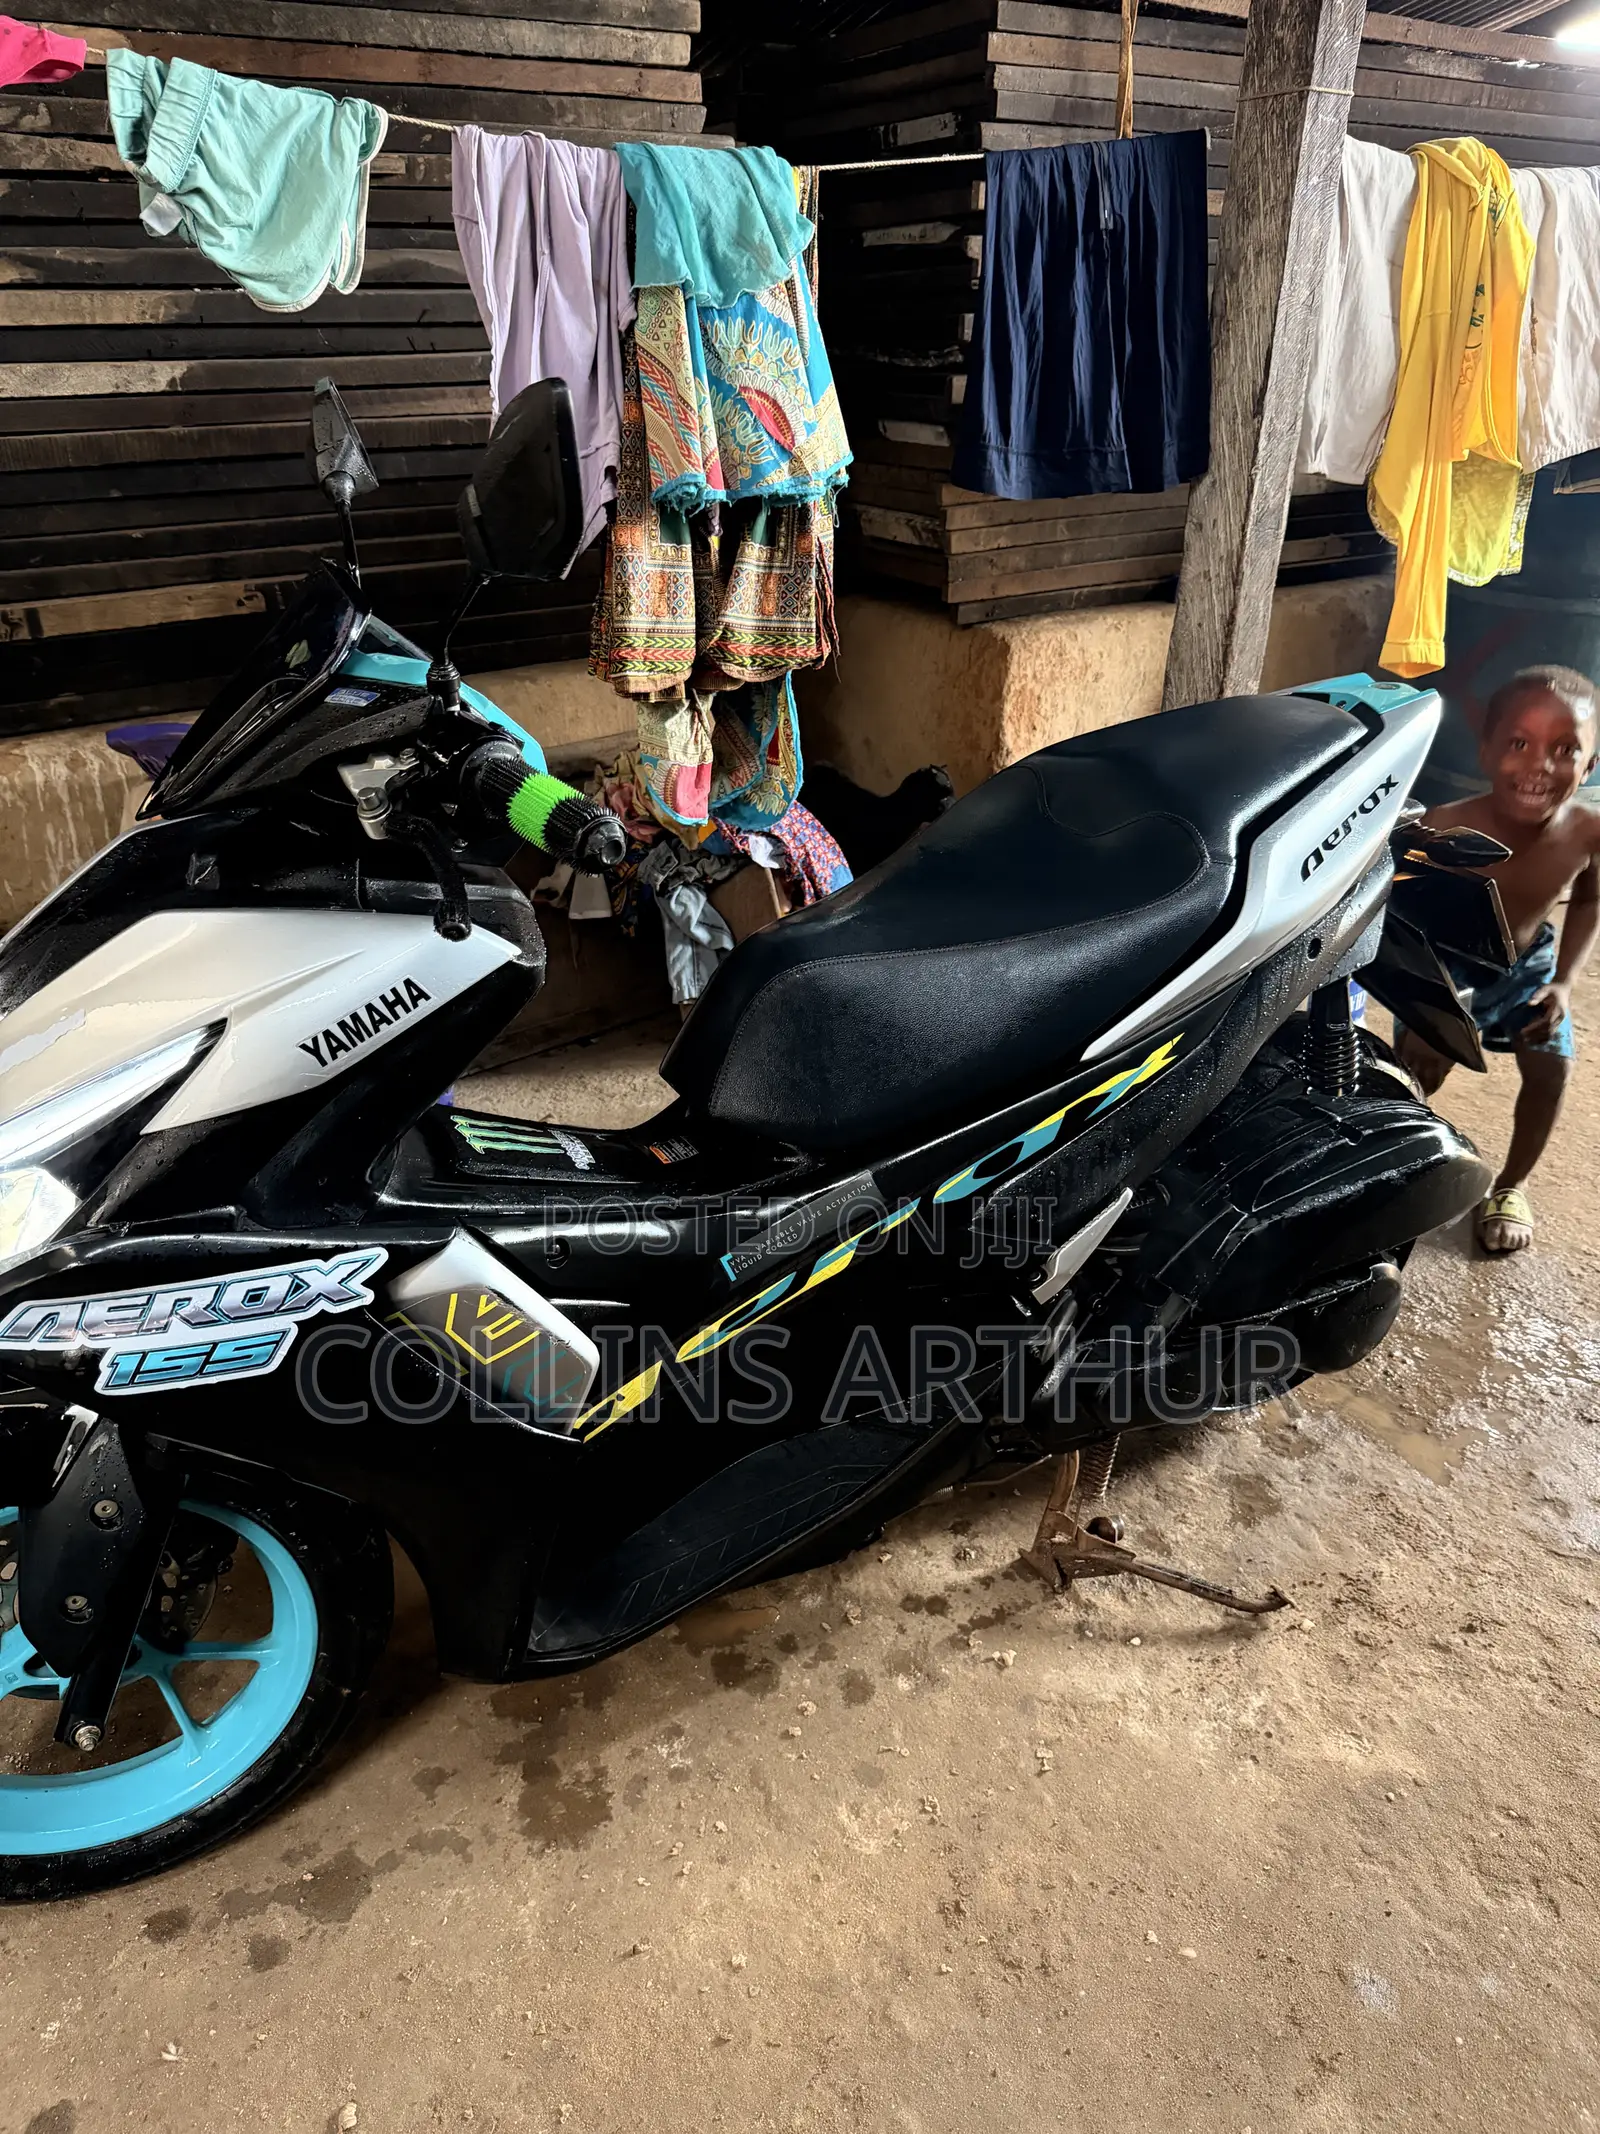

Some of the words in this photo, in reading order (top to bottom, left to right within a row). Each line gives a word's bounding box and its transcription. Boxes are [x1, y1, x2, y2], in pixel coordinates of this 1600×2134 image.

[298, 977, 432, 1067] YAMAHA
[755, 1227, 795, 1251] VARIABLE
[797, 1210, 823, 1227] VALVE
[826, 1181, 873, 1211] ACTUATION
[734, 1254, 763, 1274] LIQUID
[766, 1233, 798, 1255] COOLED
[102, 1327, 290, 1391] 155
